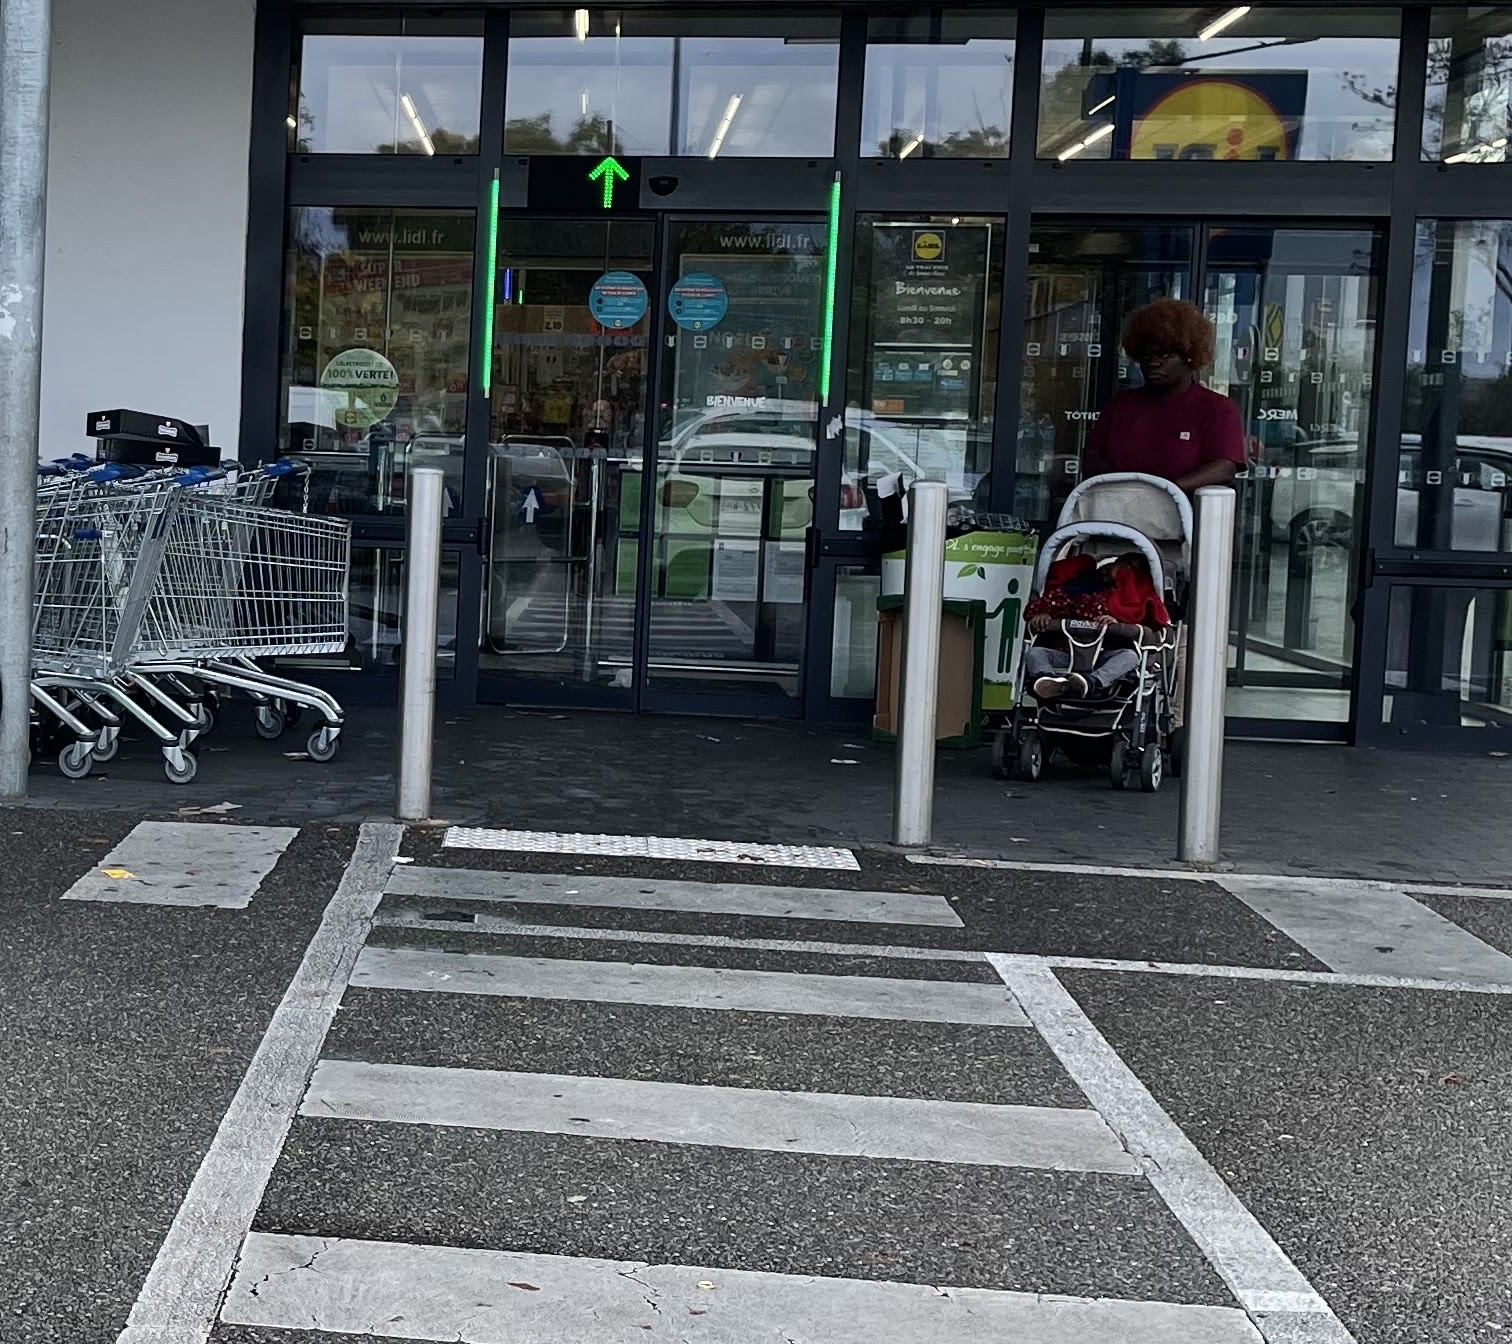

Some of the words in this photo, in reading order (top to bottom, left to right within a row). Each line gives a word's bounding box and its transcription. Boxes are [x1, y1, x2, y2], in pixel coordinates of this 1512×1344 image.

[358, 229, 445, 245] www.lidl.fr
[719, 233, 811, 248] www.lidl.fr
[361, 260, 403, 276] SUPR
[895, 281, 962, 296] Bienvenue
[934, 317, 952, 325] 20h
[706, 395, 766, 408] BIENVENUE
